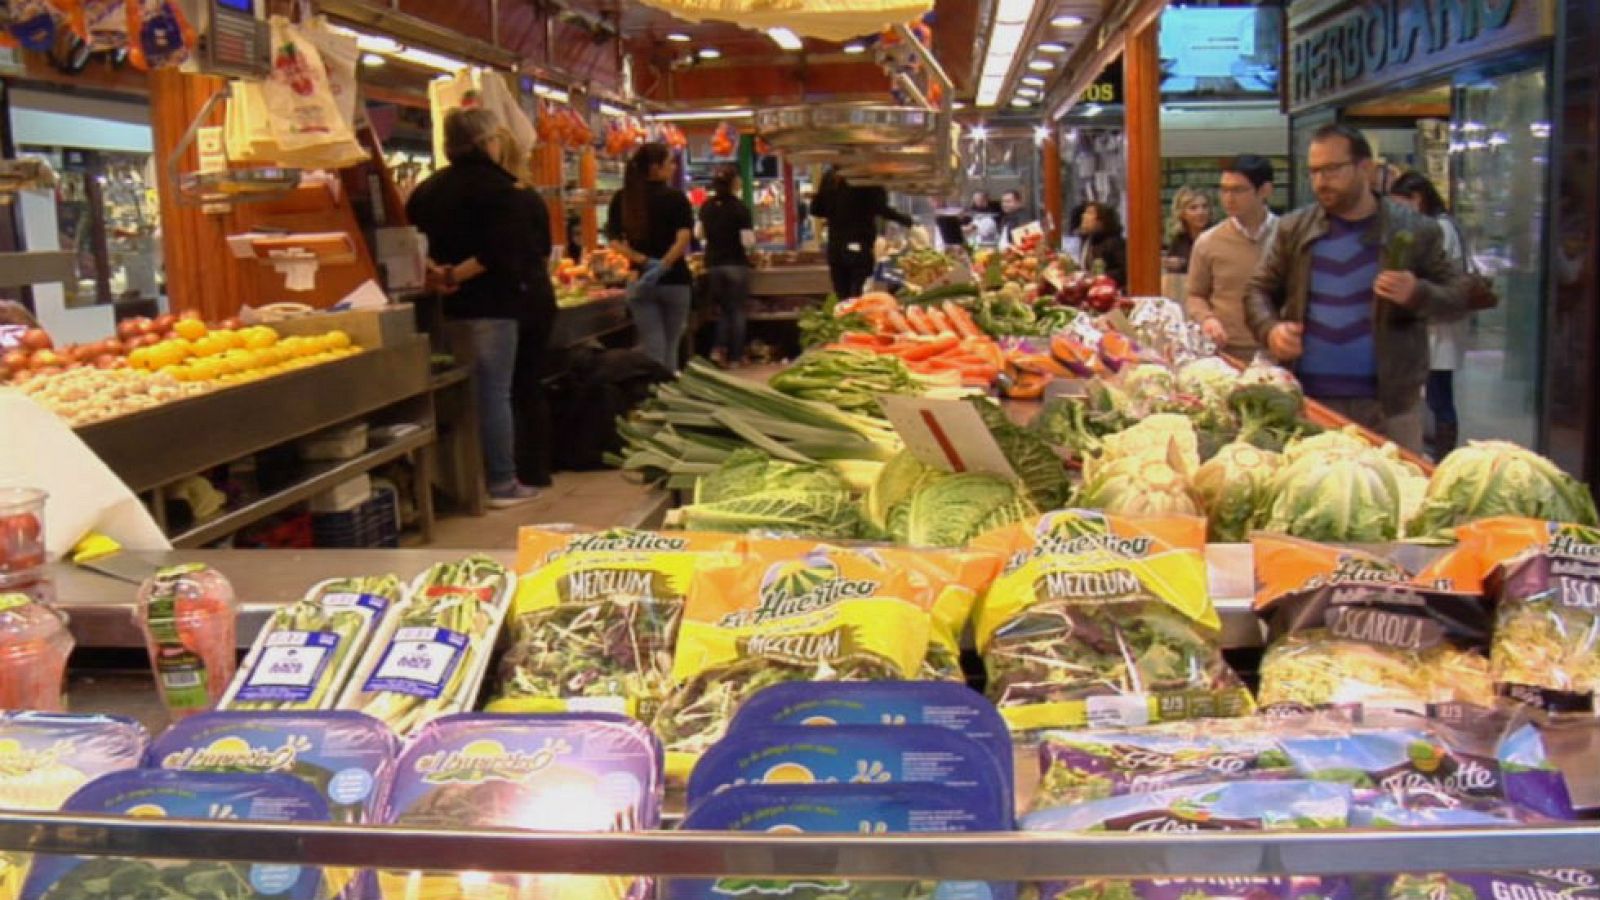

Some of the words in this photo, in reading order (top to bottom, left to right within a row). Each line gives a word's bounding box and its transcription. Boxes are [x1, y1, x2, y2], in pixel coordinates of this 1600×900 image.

[566, 533, 686, 553] Huertico
[569, 570, 653, 600] MEZCLUM
[1047, 570, 1143, 598] MEZCLUM
[753, 579, 878, 625] Huertico
[1332, 607, 1423, 649] ESCAROLA
[747, 629, 840, 660] MEZCLUM
